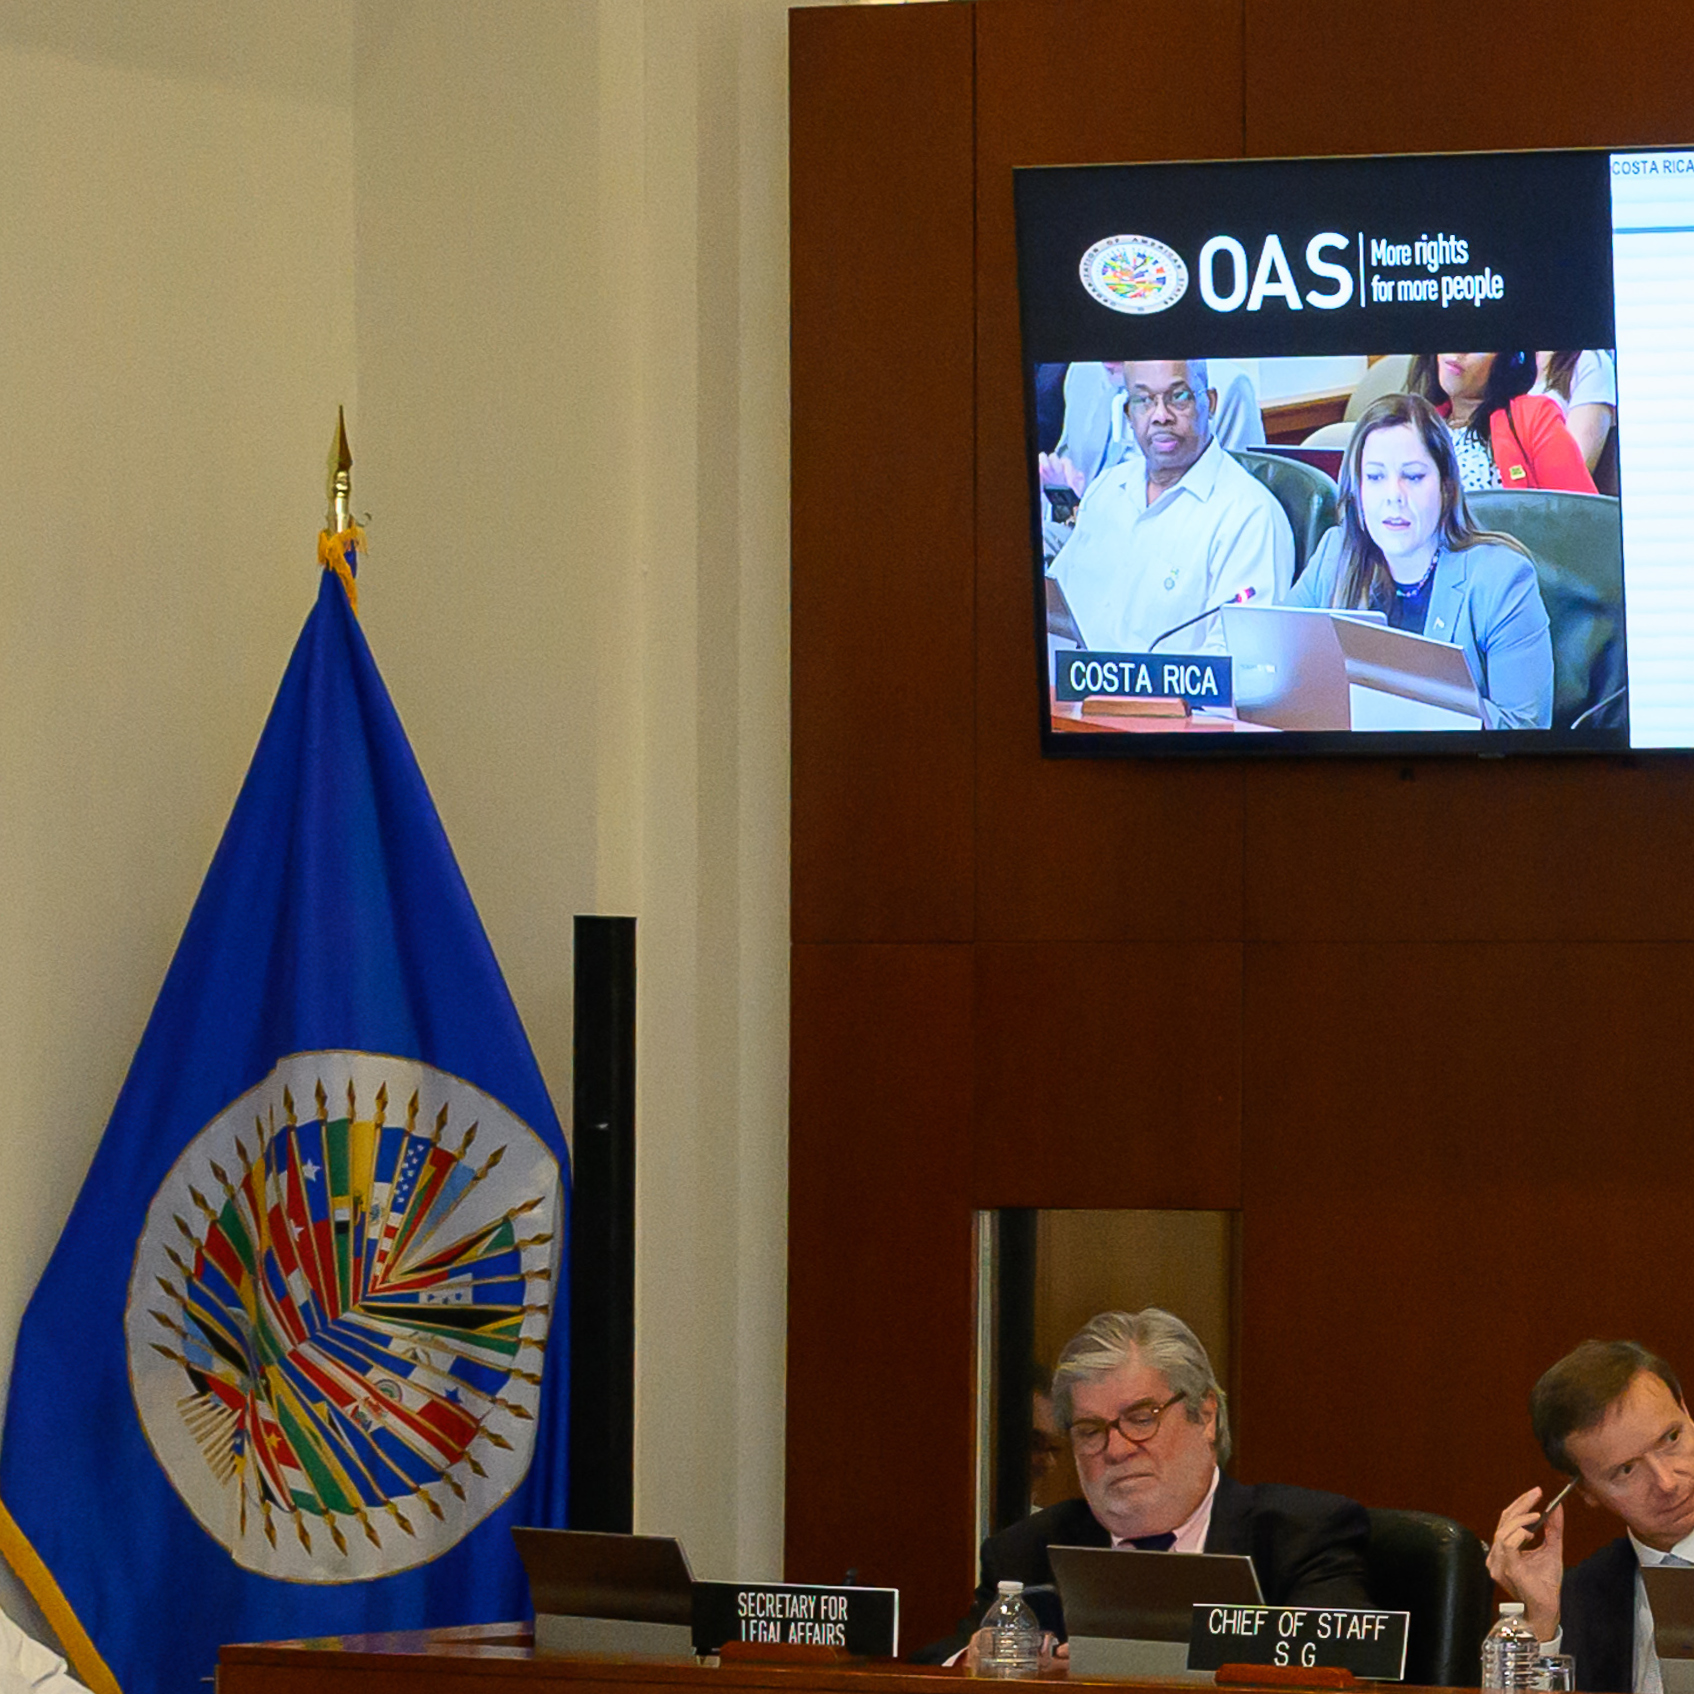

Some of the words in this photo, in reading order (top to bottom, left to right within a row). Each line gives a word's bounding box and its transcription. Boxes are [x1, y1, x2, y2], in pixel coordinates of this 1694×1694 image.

[1612, 161, 1659, 175] COSTA
[1371, 238, 1412, 267] More
[1414, 233, 1469, 273] rights
[1199, 232, 1354, 312] OAS
[1371, 275, 1395, 302] for
[1397, 276, 1438, 303] more
[1441, 267, 1504, 308] people
[1070, 661, 1152, 694] COSTA
[1163, 664, 1218, 695] RICA
[738, 1592, 817, 1619] SECRETARY
[820, 1595, 848, 1621] FOR
[741, 1619, 781, 1643] LEGAL
[788, 1622, 846, 1646] AFFAIRS
[1209, 1608, 1269, 1635] CHIEF
[1278, 1611, 1307, 1637] OF
[1317, 1613, 1390, 1641] STAFF
[1274, 1641, 1290, 1666] S
[1301, 1642, 1316, 1668] G
